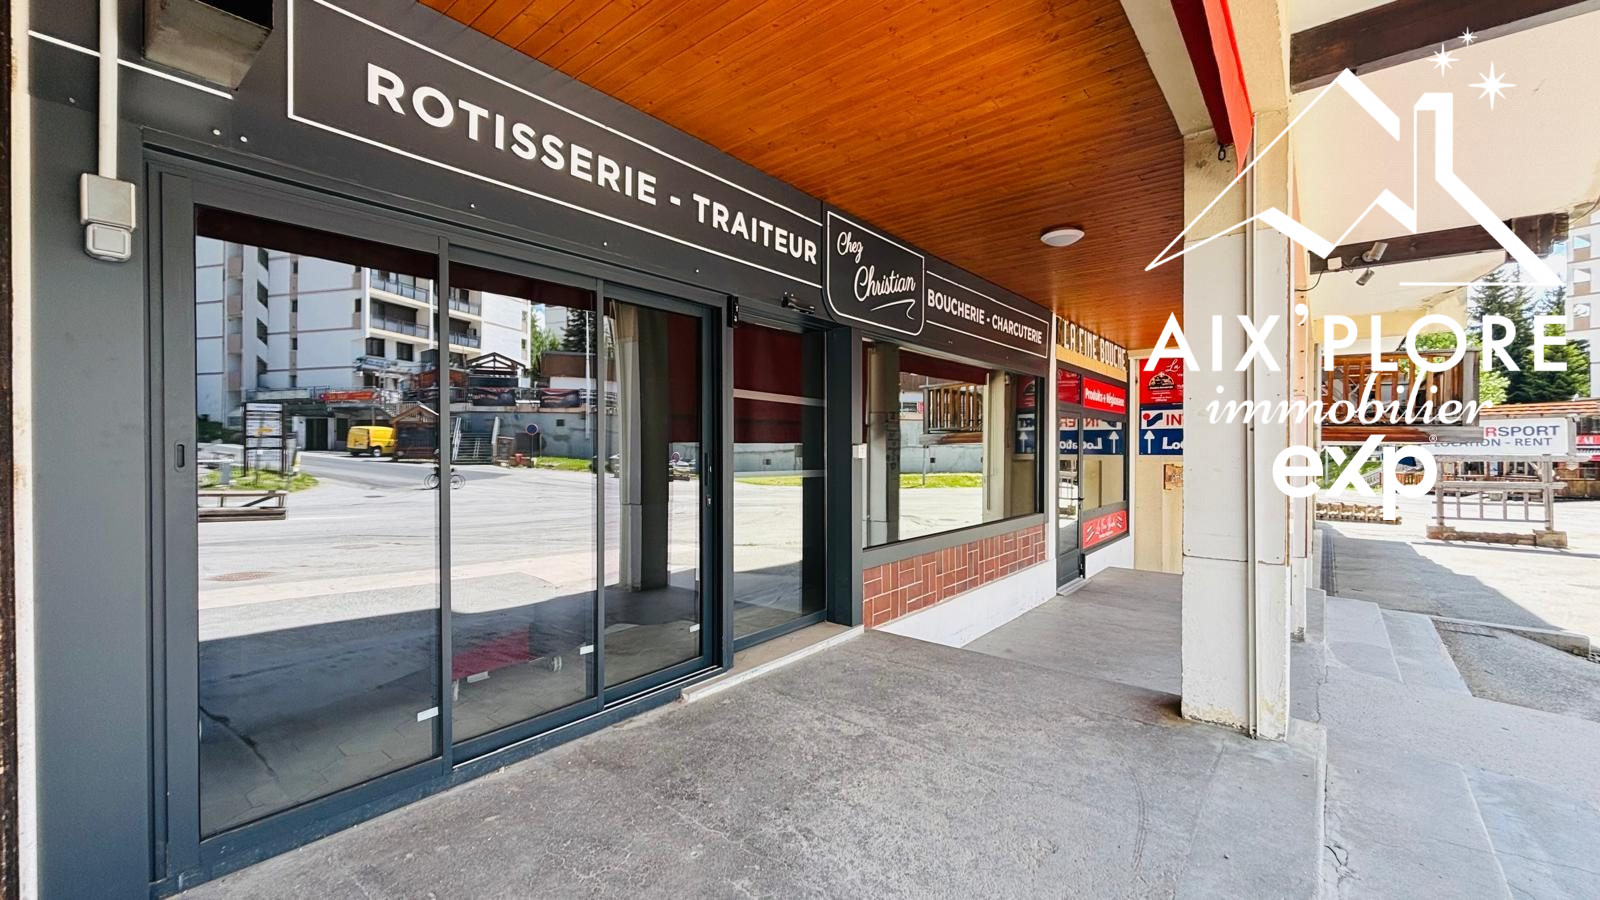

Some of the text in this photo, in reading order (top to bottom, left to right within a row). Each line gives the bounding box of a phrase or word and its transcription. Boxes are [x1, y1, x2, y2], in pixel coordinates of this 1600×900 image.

[367, 62, 657, 207] ROTISSERIE
[692, 193, 818, 265] TRAITEUR
[837, 231, 864, 263] Chez
[854, 265, 916, 301] Christian
[927, 288, 985, 325] BOUCHERIE
[991, 314, 1043, 344] CHARCUTERIE
[1064, 320, 1076, 352] LA
[1485, 425, 1560, 438] RSPORT
[1515, 437, 1552, 447] RENT
